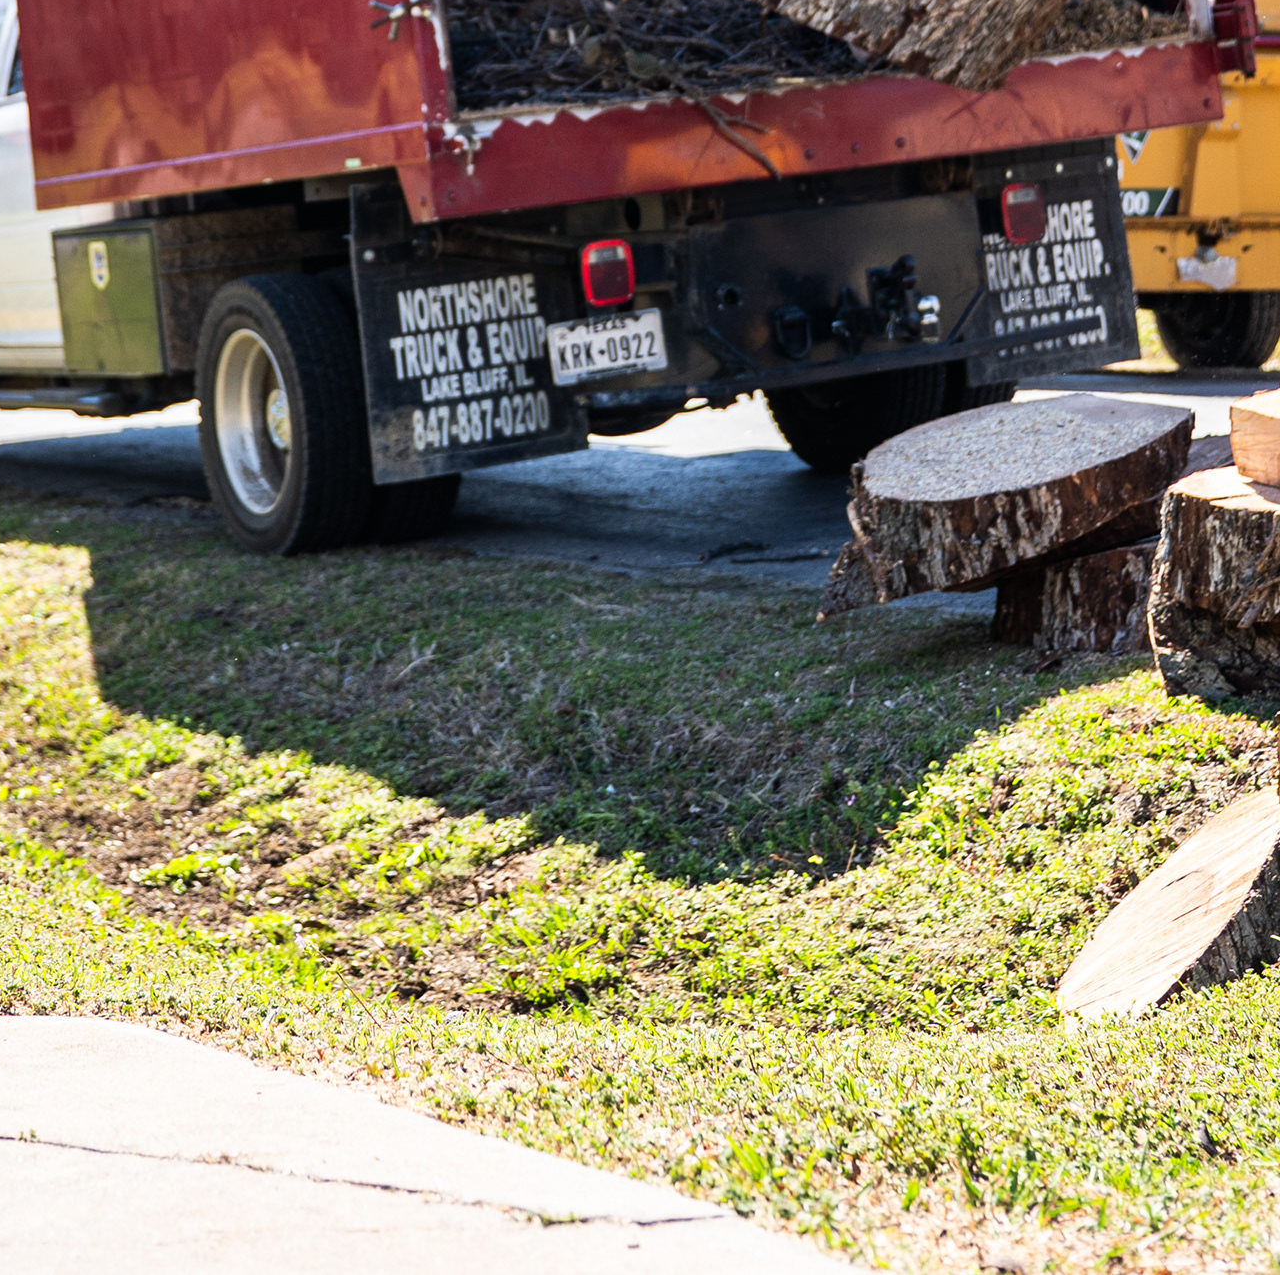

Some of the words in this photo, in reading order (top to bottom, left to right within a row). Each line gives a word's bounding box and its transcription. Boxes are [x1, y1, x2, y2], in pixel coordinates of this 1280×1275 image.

[985, 248, 1034, 292] RUCK
[1036, 246, 1051, 285] &
[1052, 238, 1111, 284] EQUIP.
[398, 274, 537, 333] NORTHSHORE
[1000, 289, 1034, 314] LAKE
[1034, 283, 1078, 309] BLUFF,
[390, 328, 464, 380] TRUCK
[466, 326, 485, 368] &
[421, 374, 461, 402] LAKE
